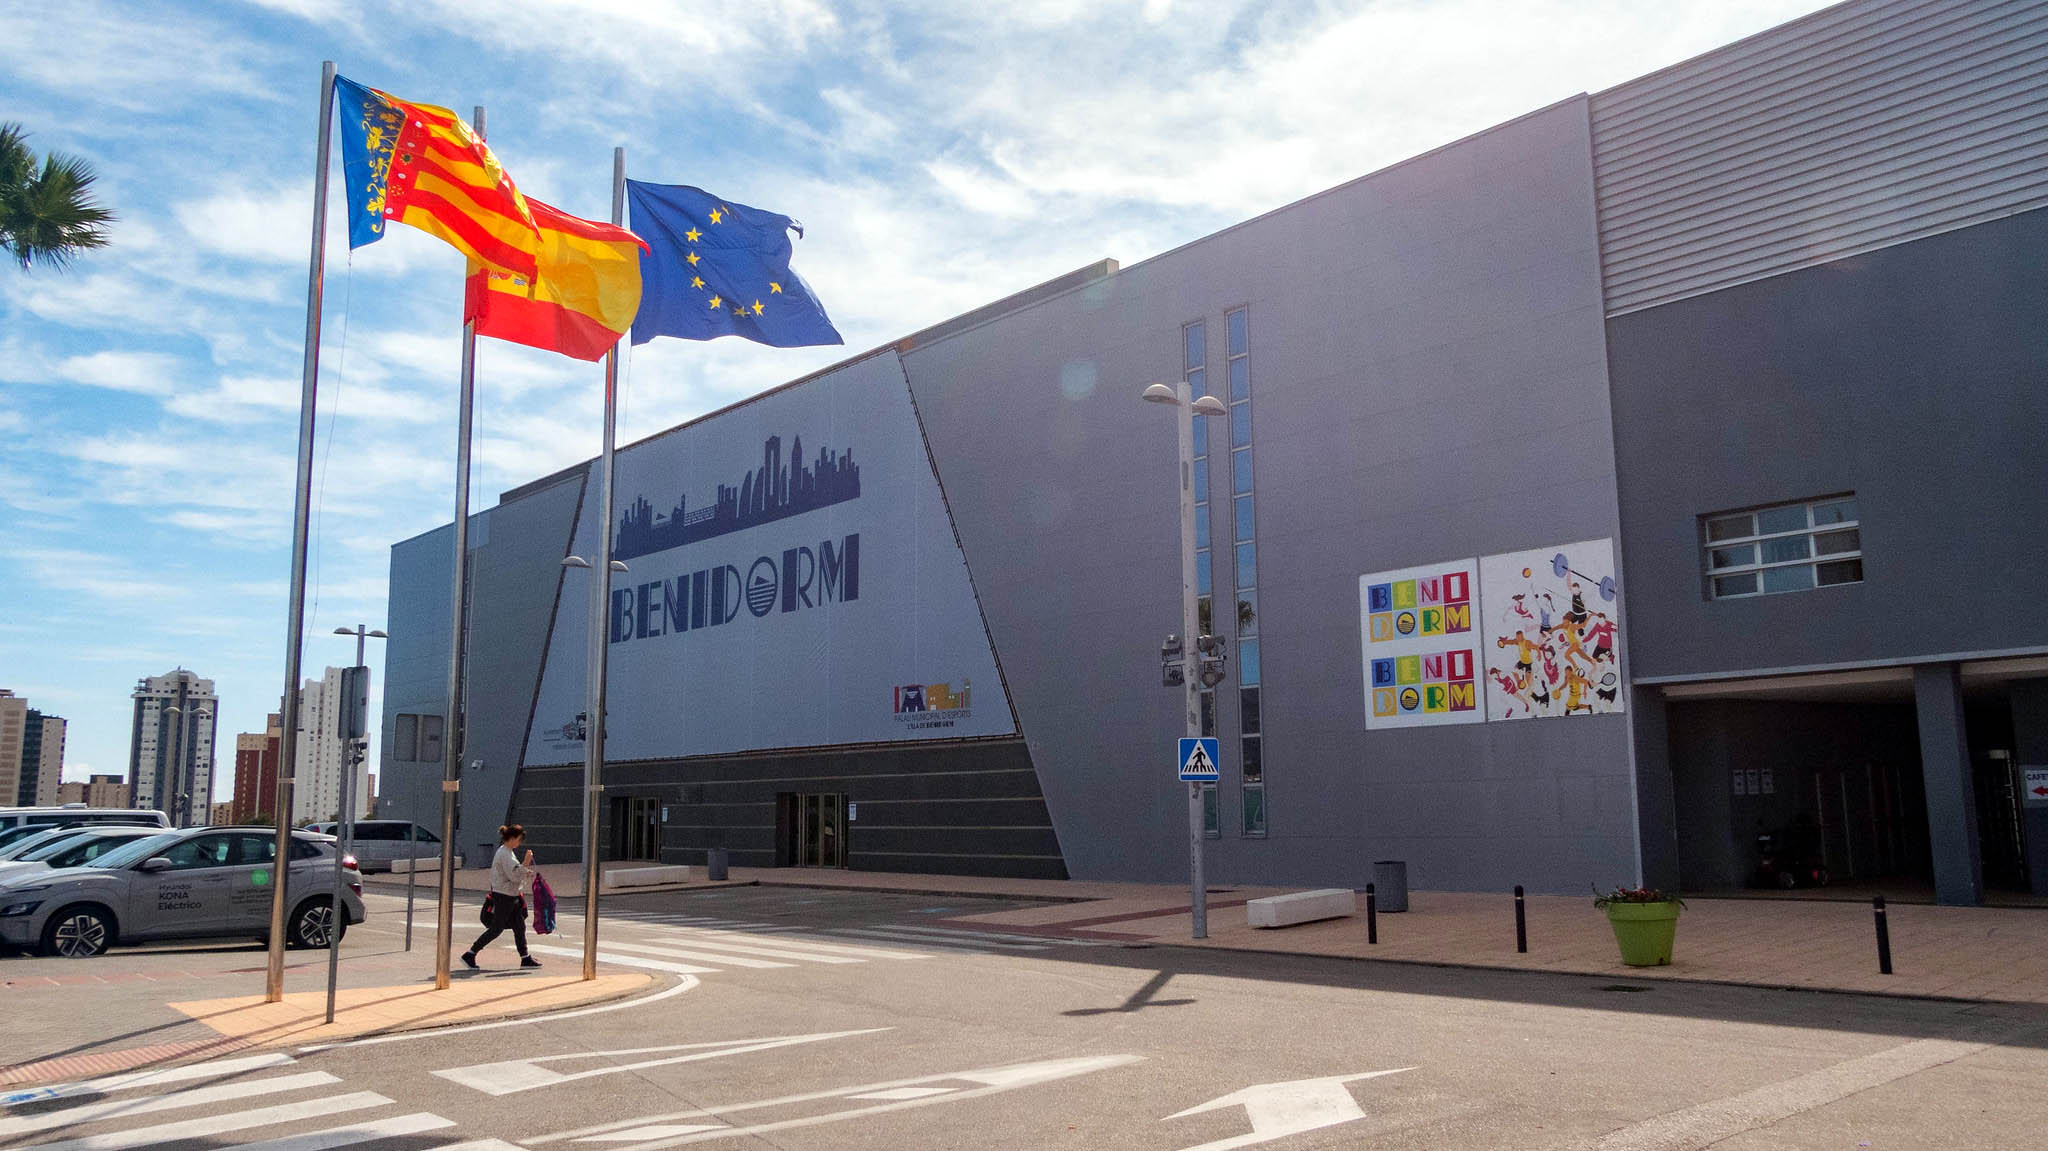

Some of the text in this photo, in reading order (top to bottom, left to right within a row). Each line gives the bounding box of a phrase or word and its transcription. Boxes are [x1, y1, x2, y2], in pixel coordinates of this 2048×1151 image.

[610, 533, 860, 644] BENIDORM
[1370, 573, 1467, 611] BENI
[1371, 603, 1470, 640] DORM
[1373, 651, 1471, 686] BENI
[1375, 682, 1474, 714] DORM
[2026, 773, 2048, 781] CAFE
[159, 892, 189, 900] KONA
